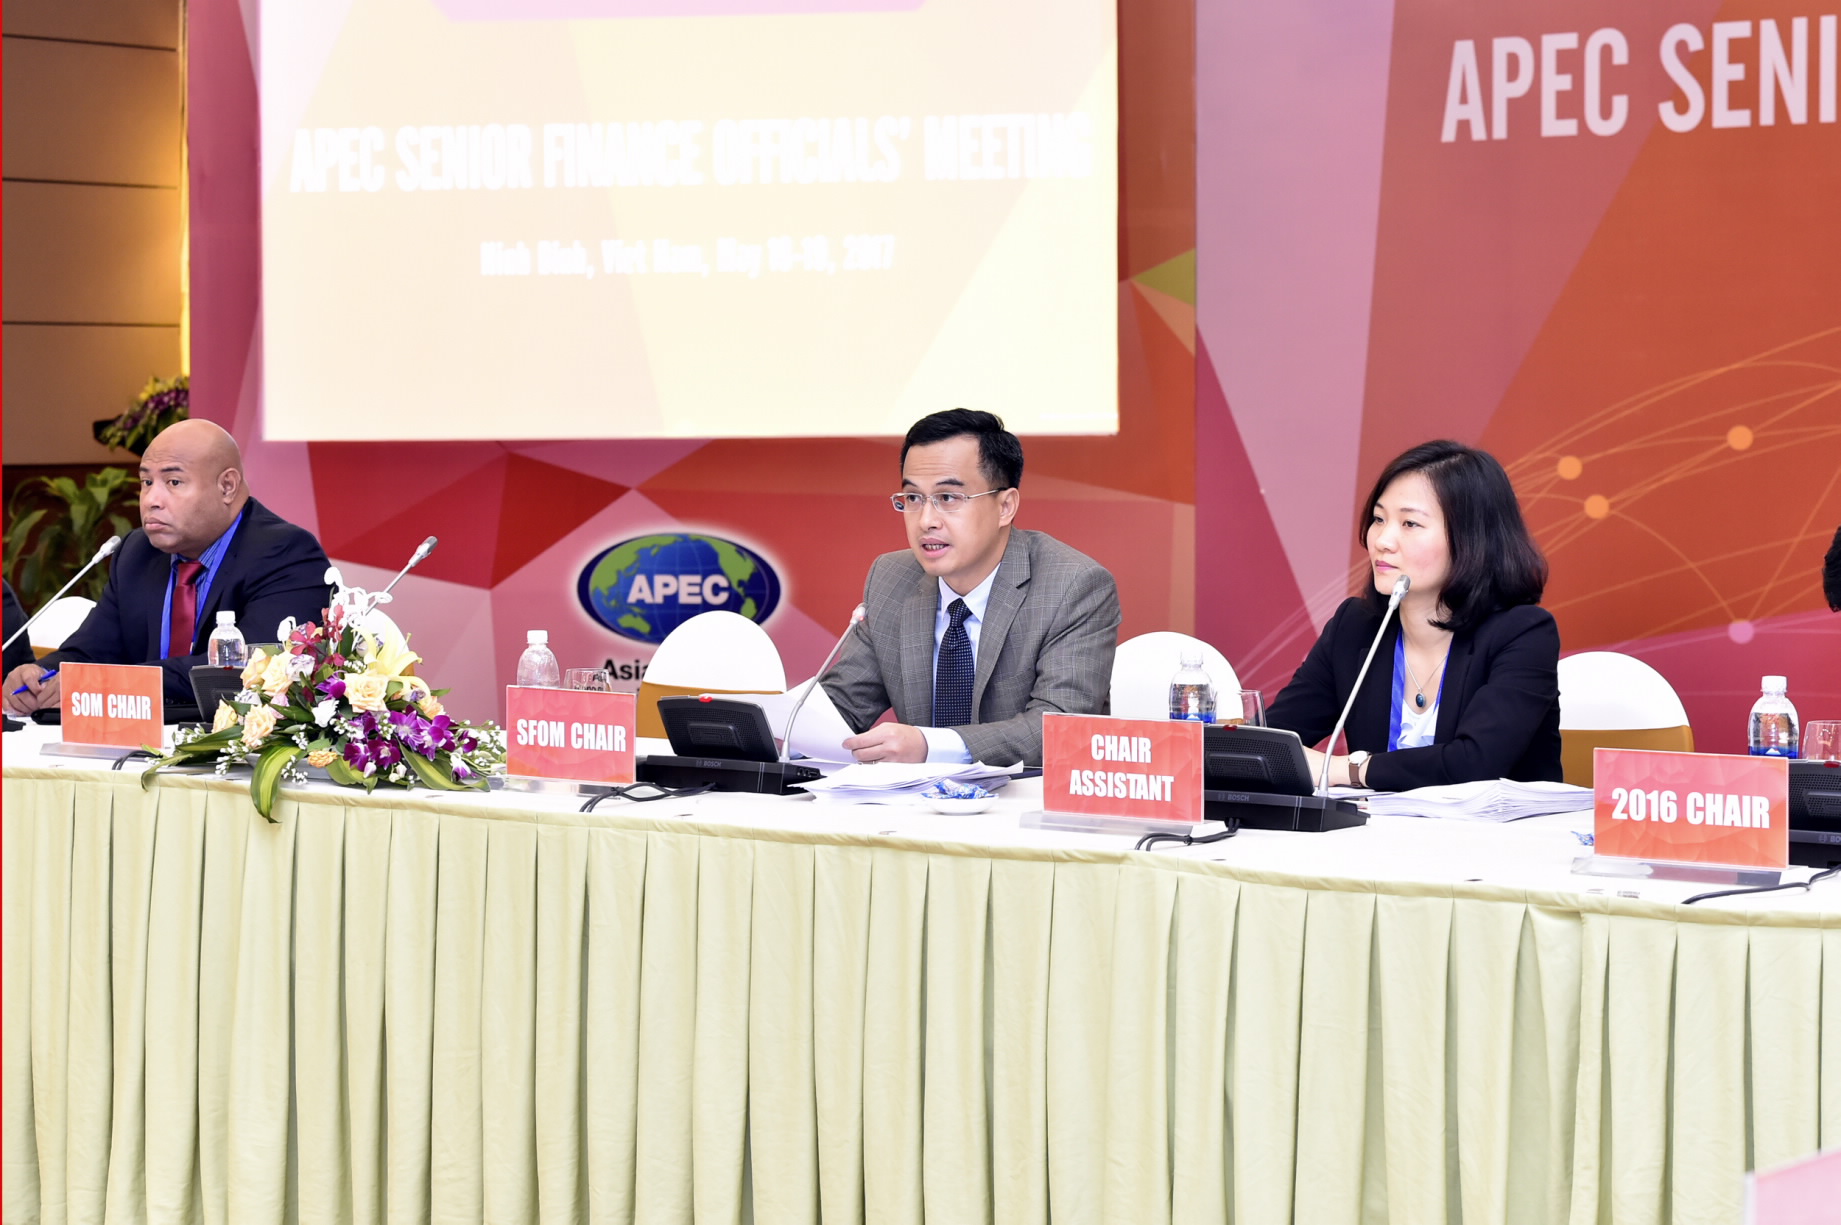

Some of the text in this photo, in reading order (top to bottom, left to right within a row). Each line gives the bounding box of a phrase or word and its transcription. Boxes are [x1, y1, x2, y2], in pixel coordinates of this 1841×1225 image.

[1441, 14, 1838, 143] APEC SENI
[289, 111, 1093, 193] APEC SENIOR FINANCE OFFICIALS' MEETING
[627, 574, 730, 605] APEC
[71, 691, 152, 721] SOM CHAIR
[516, 718, 627, 752] SFOM CHAIR
[1091, 734, 1152, 764] CHAIR
[1069, 769, 1175, 803] ASSISTANT
[1611, 787, 1770, 829] 2016 CHAIR
